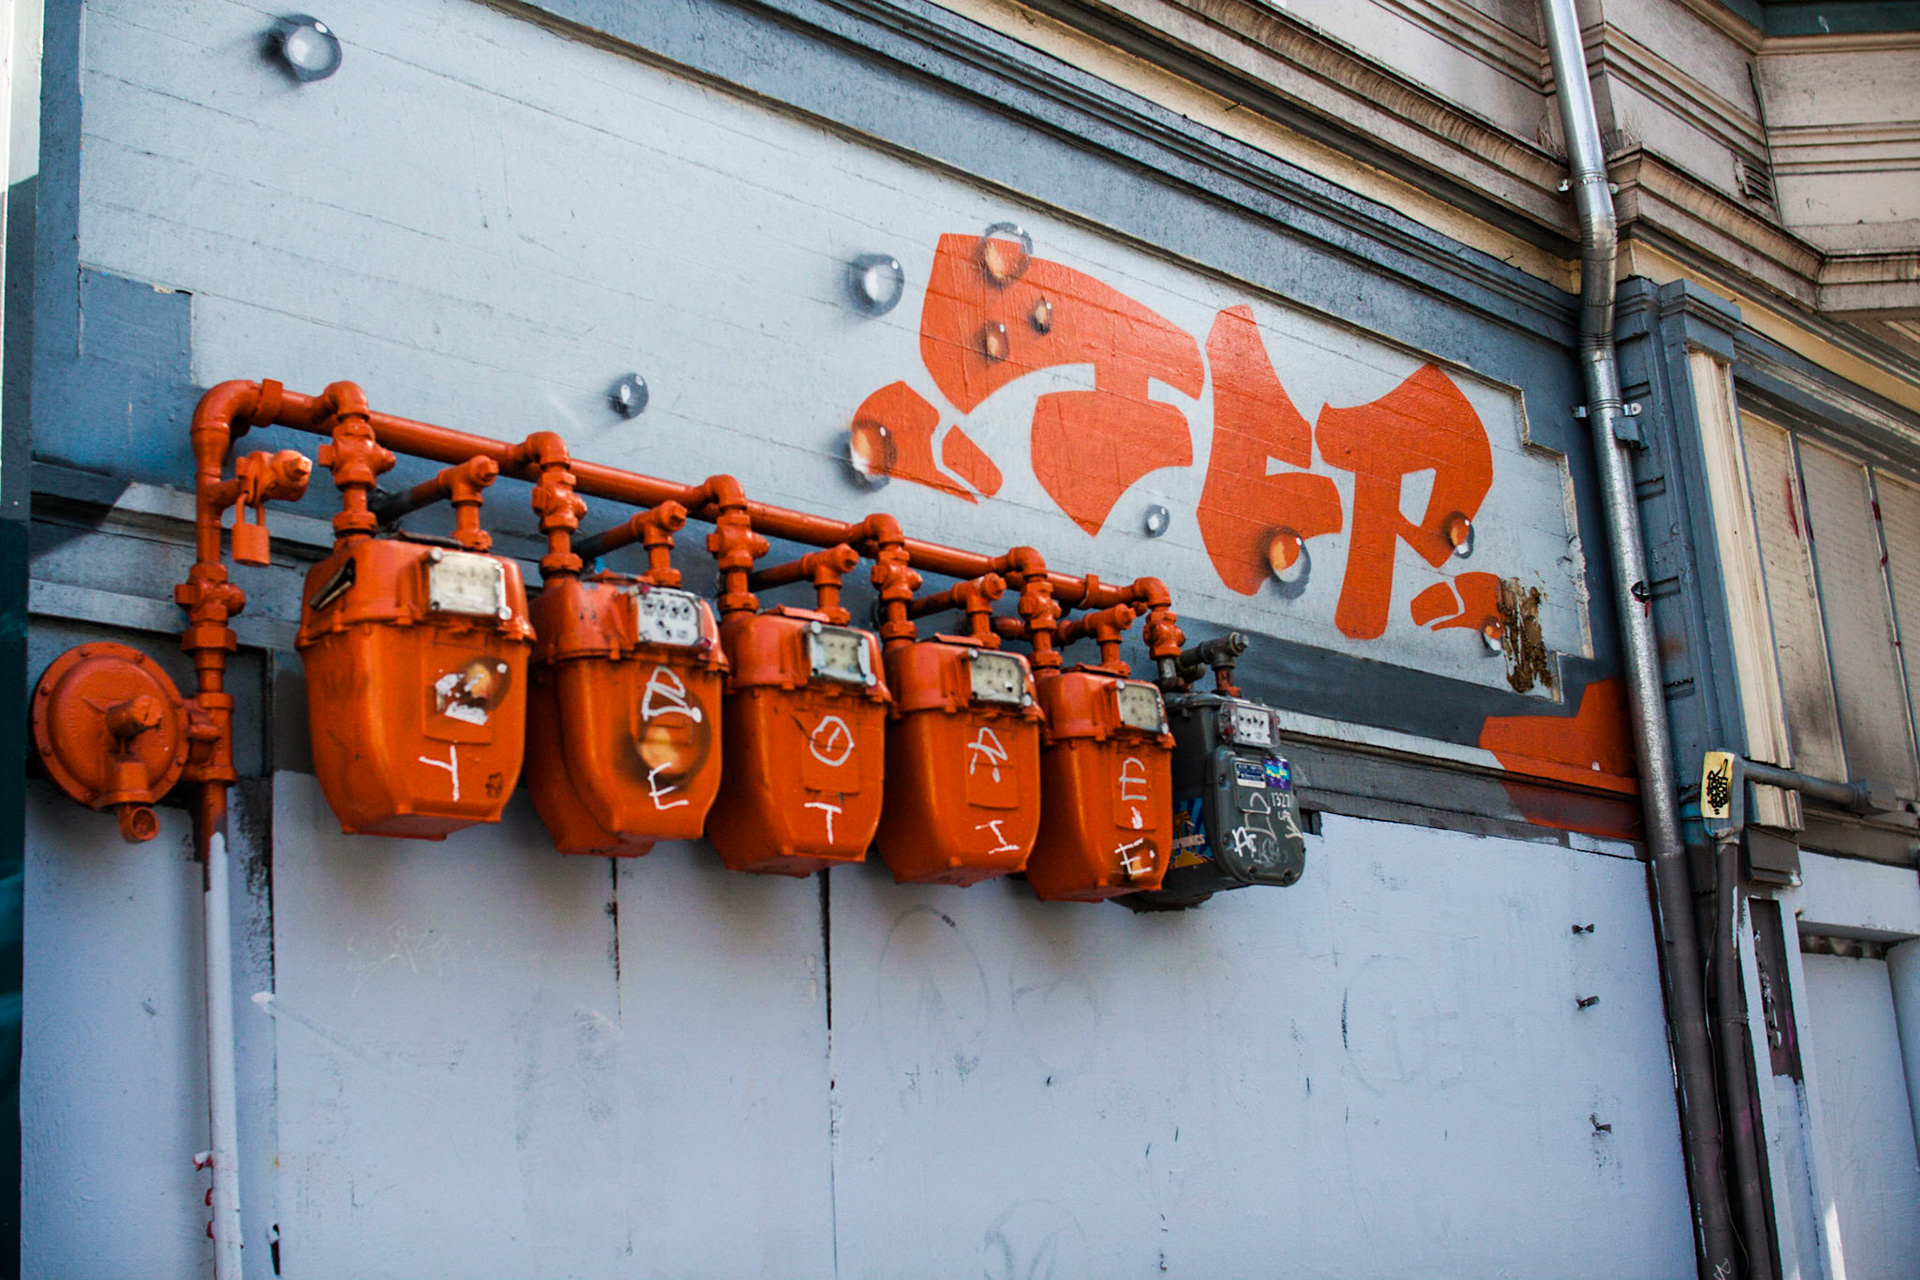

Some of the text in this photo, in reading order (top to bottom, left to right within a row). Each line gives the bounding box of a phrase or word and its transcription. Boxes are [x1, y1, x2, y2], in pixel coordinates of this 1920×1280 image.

[419, 746, 459, 801] Y
[648, 761, 689, 810] E
[804, 802, 842, 844] T
[1271, 792, 1290, 808] 1327
